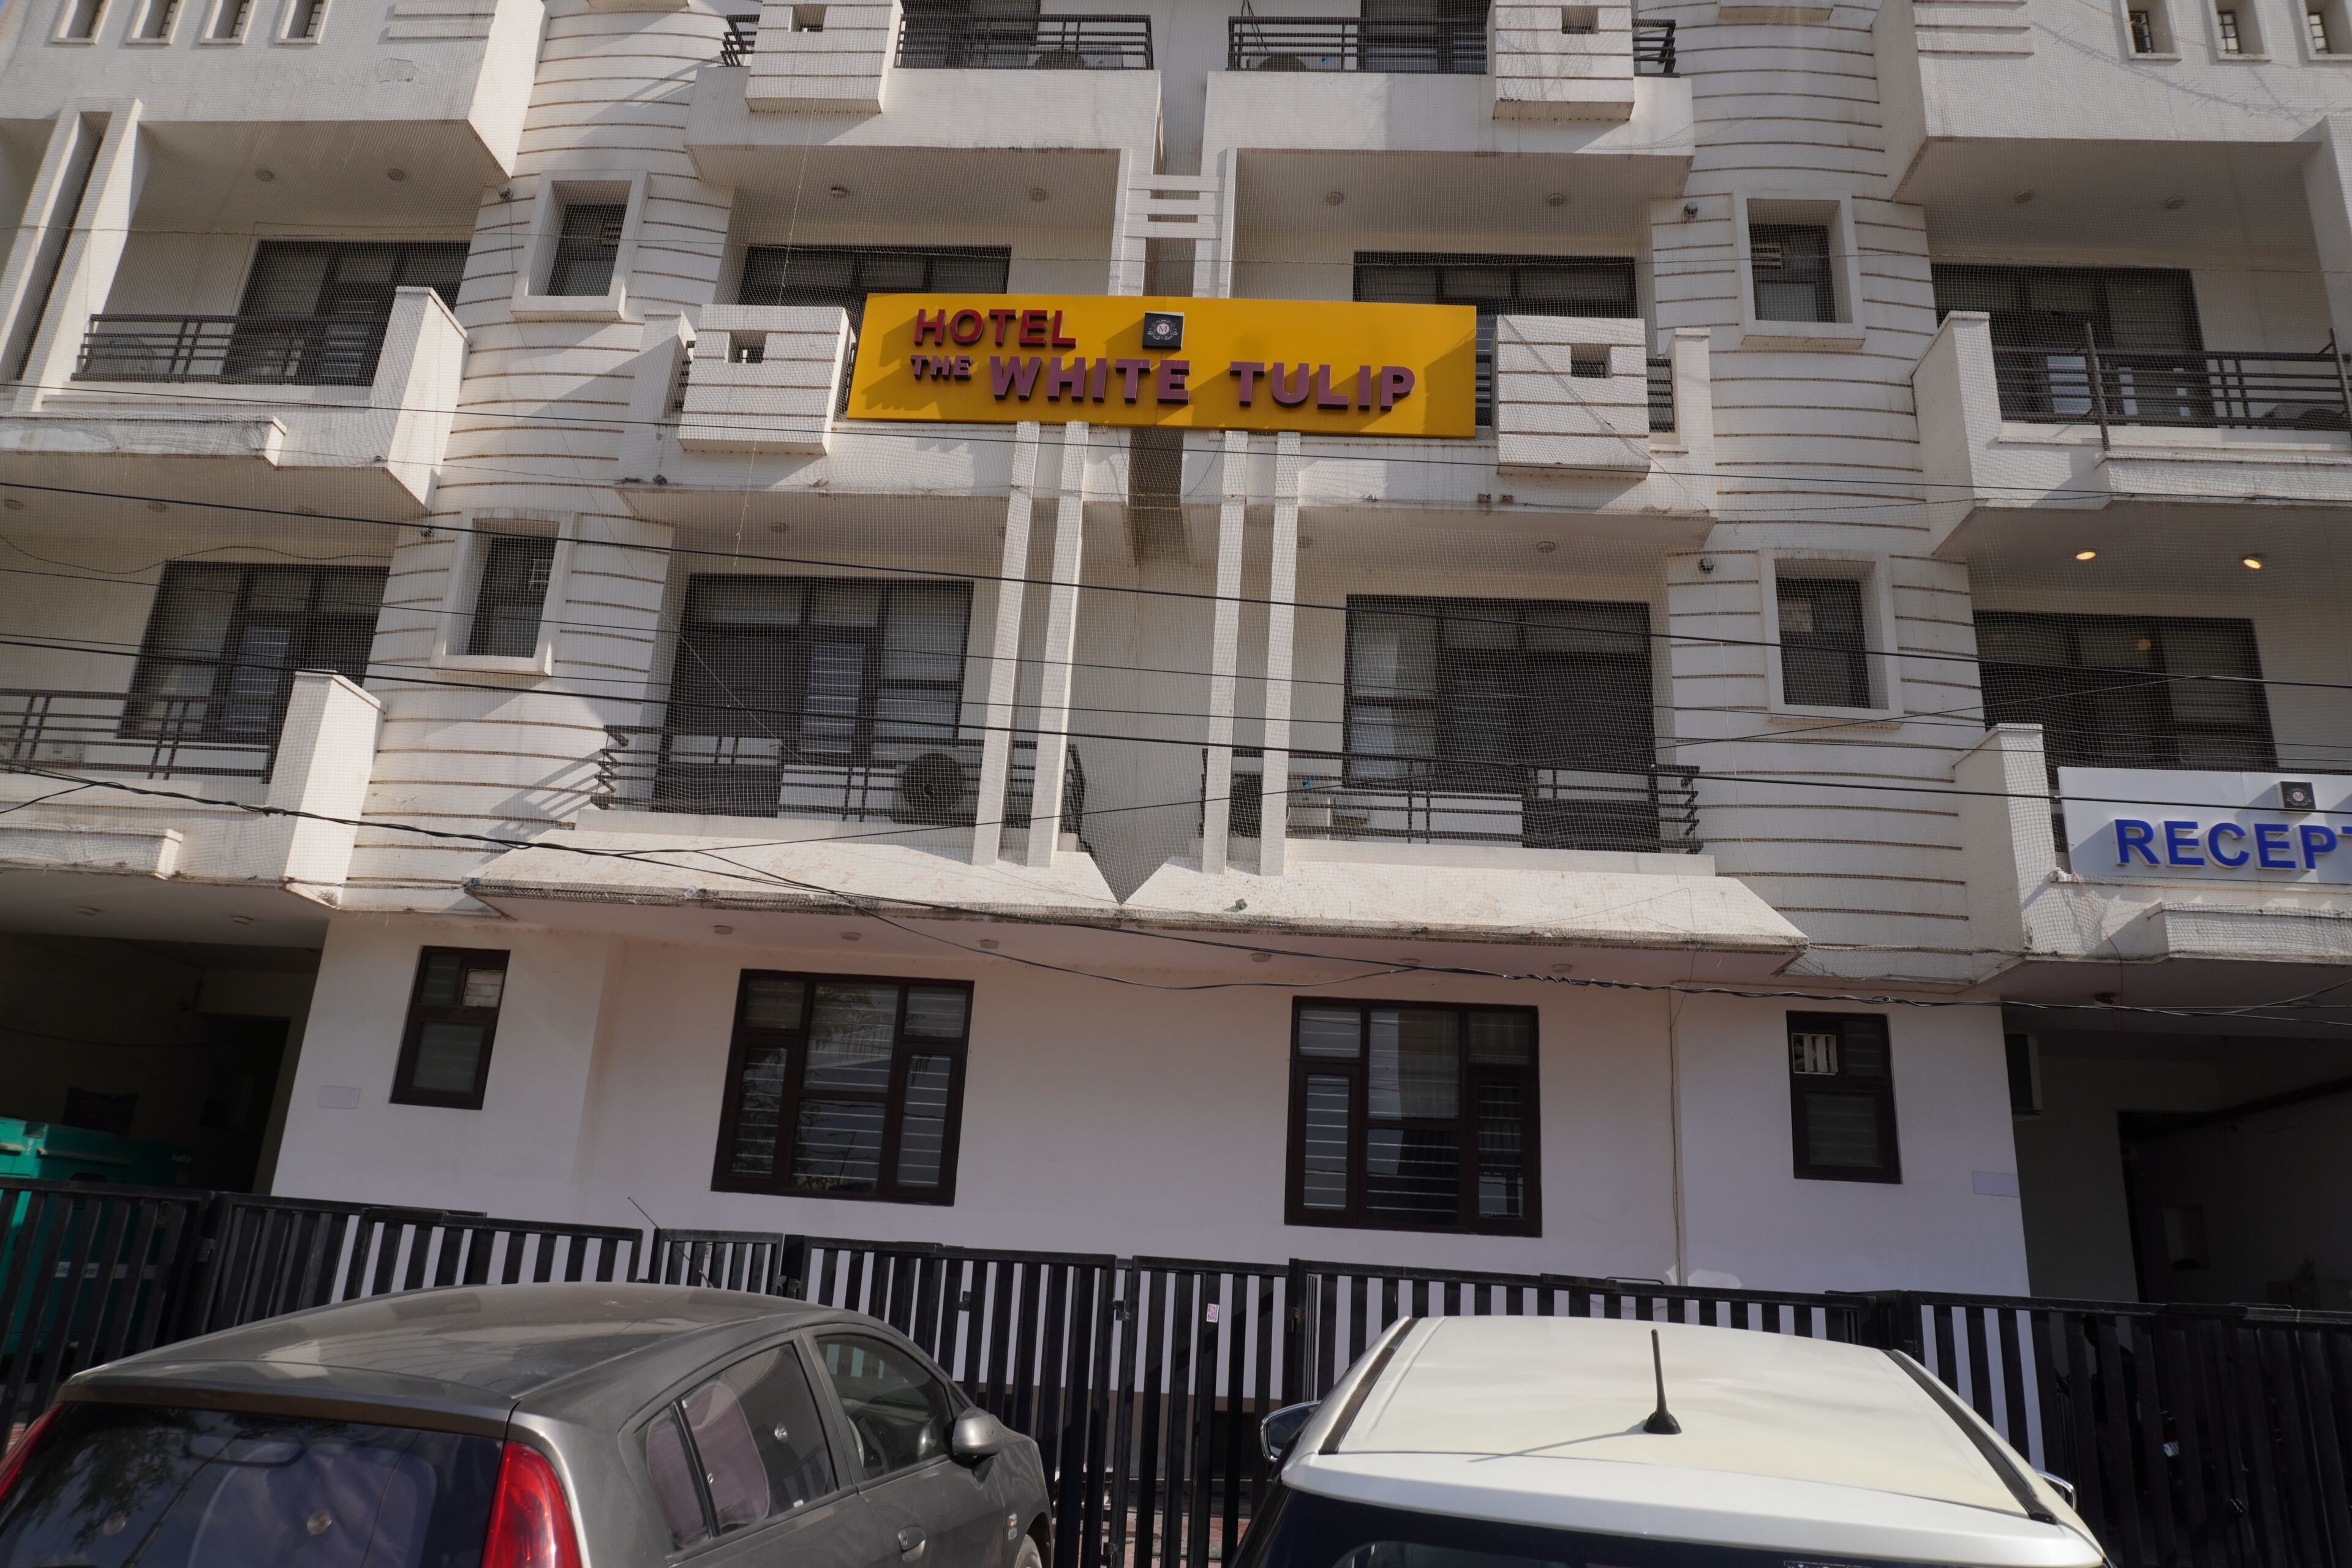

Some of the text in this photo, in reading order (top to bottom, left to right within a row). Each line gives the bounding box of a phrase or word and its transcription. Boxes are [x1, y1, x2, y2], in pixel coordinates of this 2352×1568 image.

[914, 309, 1076, 347] HOTEL
[910, 355, 1415, 411] THE WHITE TULIP
[2114, 818, 2352, 870] RECEP
